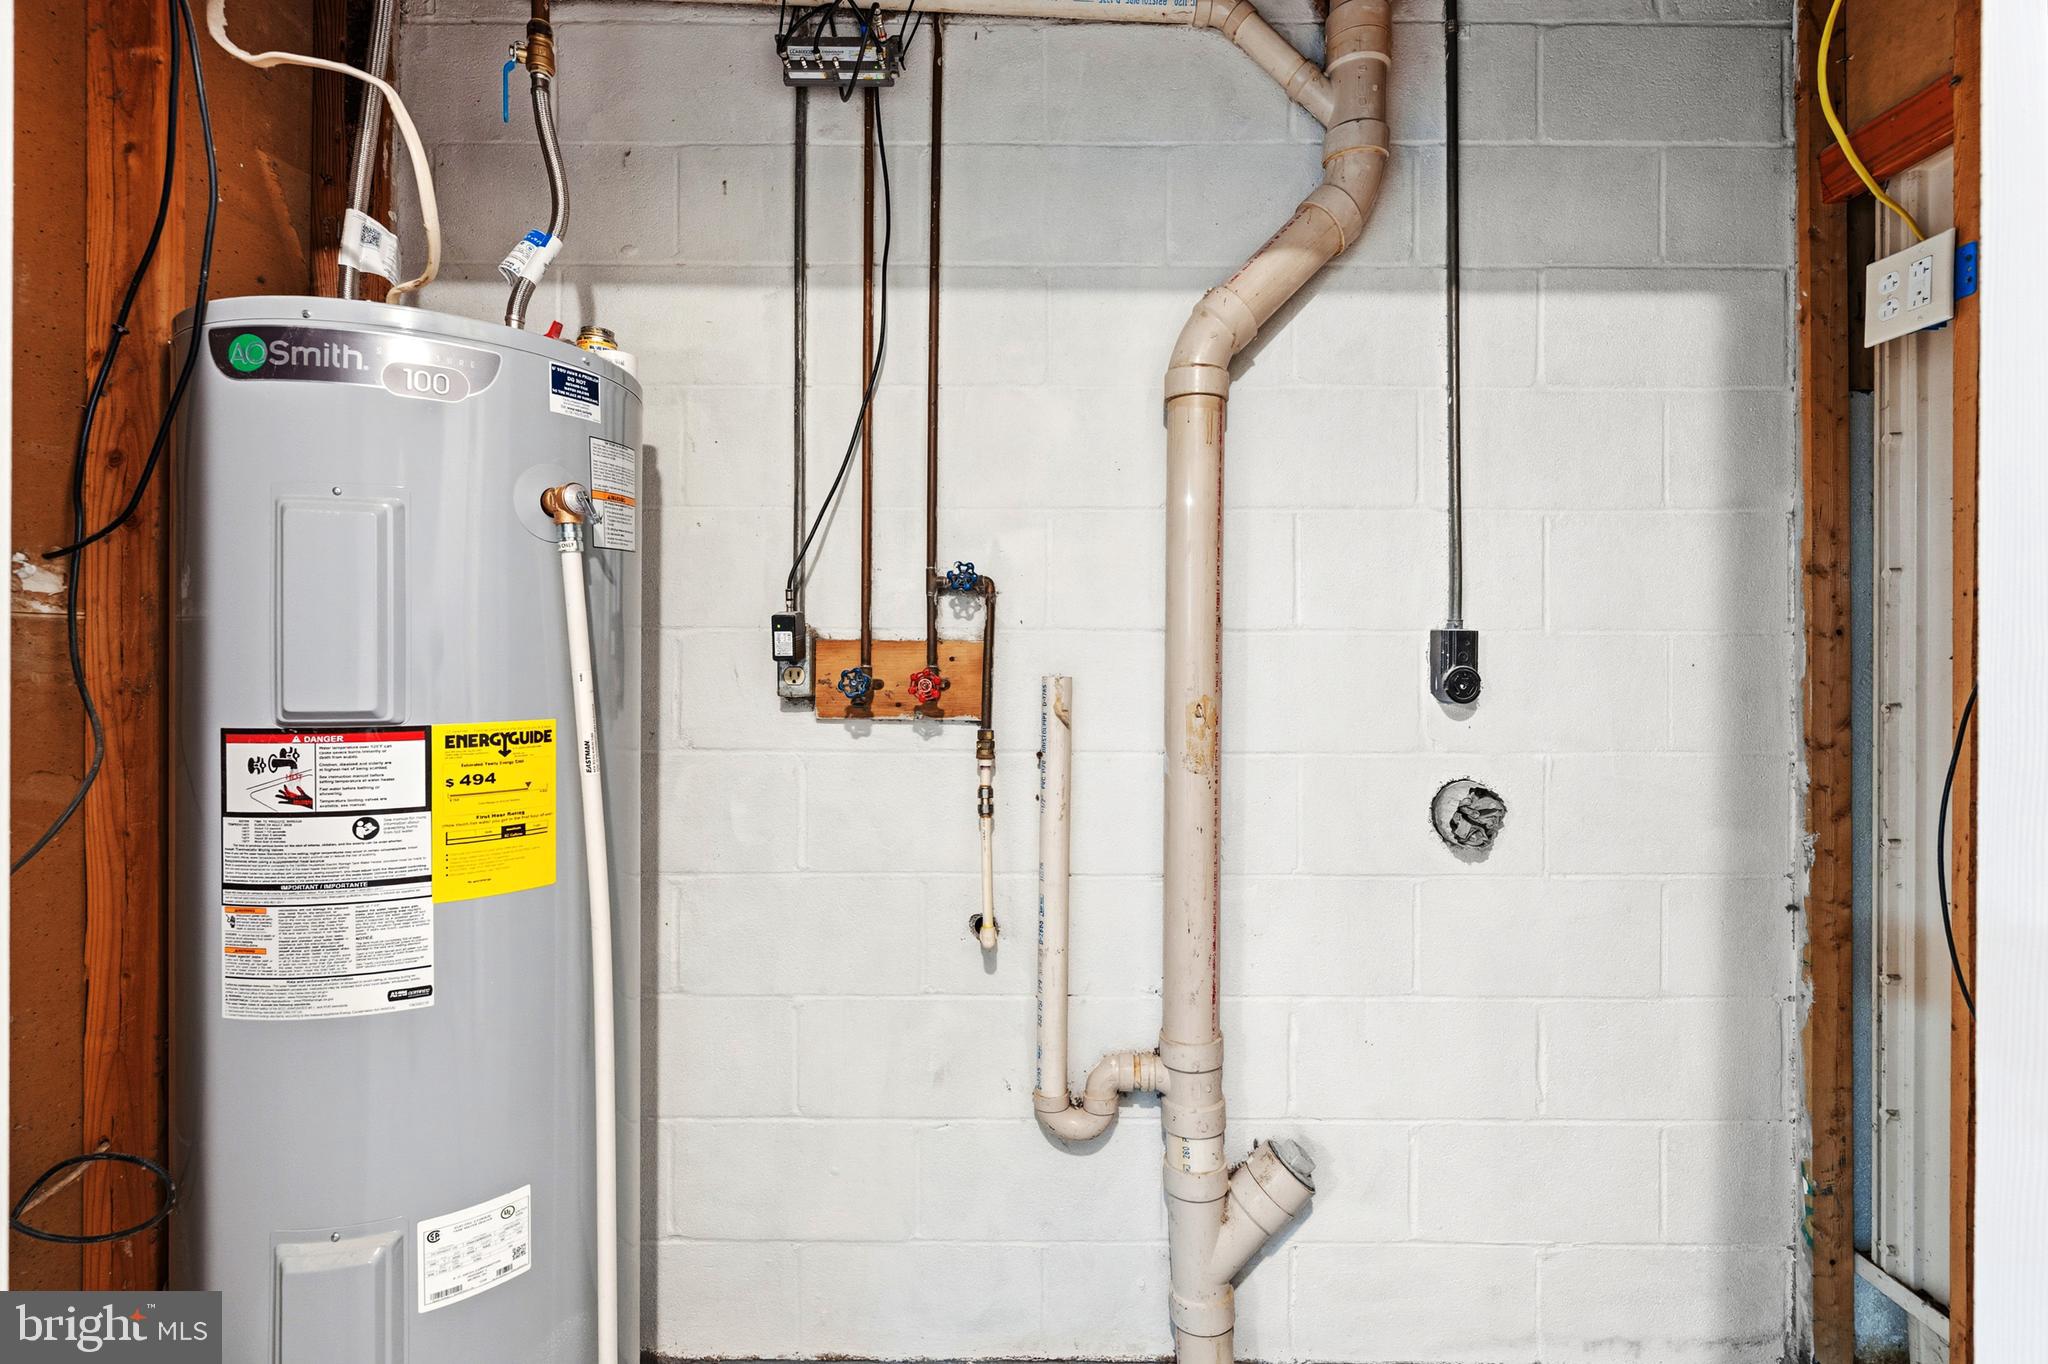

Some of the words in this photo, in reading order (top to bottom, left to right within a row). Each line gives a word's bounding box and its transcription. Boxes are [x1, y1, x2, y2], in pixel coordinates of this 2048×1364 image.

[402, 368, 450, 395] 100
[576, 378, 586, 386] NOT
[304, 735, 344, 743] DANGER
[445, 730, 552, 753] ENERGYGUIDE
[446, 778, 454, 788] $
[459, 772, 496, 786] 494
